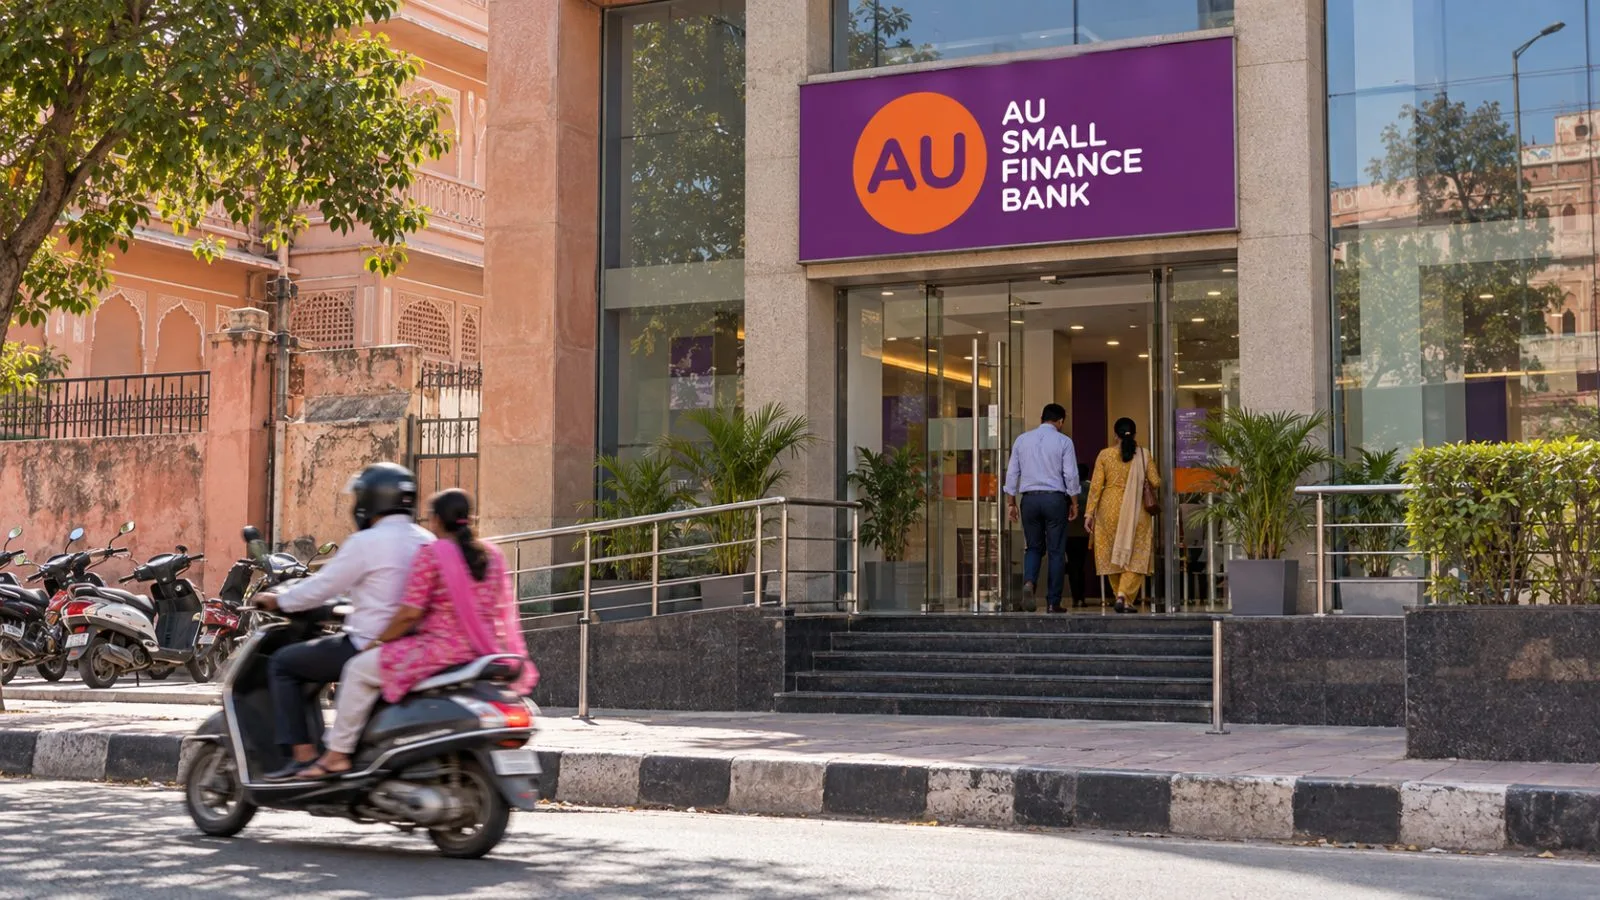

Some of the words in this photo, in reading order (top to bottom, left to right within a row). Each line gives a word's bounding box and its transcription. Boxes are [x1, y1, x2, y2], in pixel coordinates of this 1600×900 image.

[1001, 98, 1046, 126] AU
[1001, 122, 1107, 154] SMALL
[866, 132, 966, 194] AU
[1002, 148, 1143, 183] FINANCE
[1002, 181, 1090, 212] BANK
